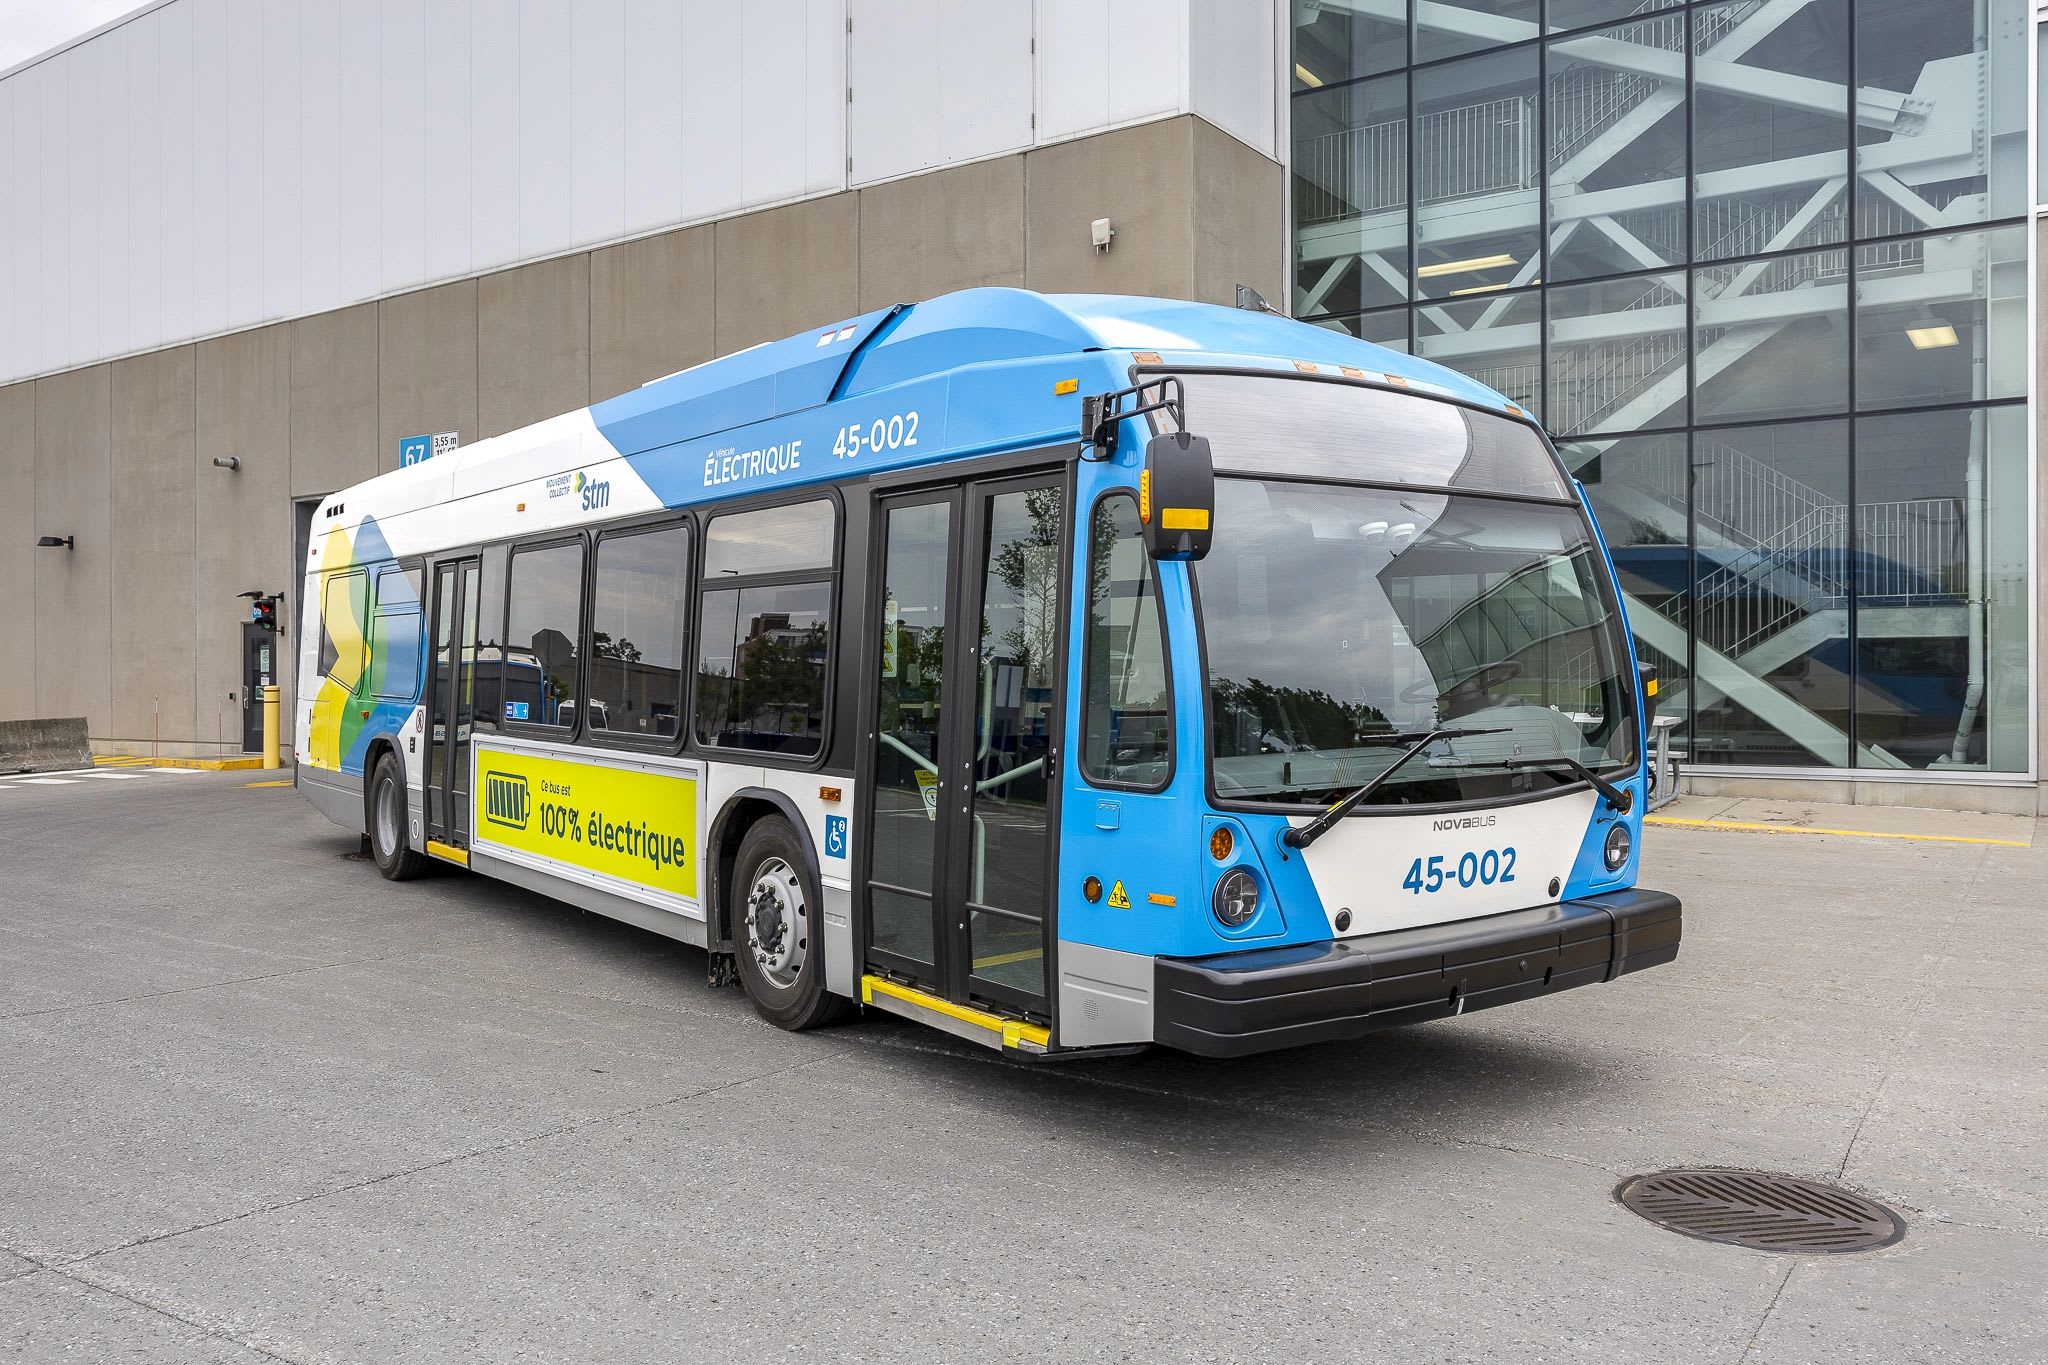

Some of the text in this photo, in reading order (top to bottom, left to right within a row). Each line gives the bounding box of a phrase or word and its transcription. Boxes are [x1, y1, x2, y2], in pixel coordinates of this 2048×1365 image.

[434, 436, 457, 448] 3,55 m
[832, 410, 919, 459] 45-002
[405, 444, 425, 467] 67
[703, 440, 802, 487] ÉLECTRIQUE
[546, 474, 572, 488] MOUVEMENT
[549, 486, 571, 499] COLLECTIF
[582, 478, 610, 511] stm
[540, 779, 571, 797] Ce bus est
[587, 811, 685, 871] électrique
[1402, 846, 1517, 895] 45-002
